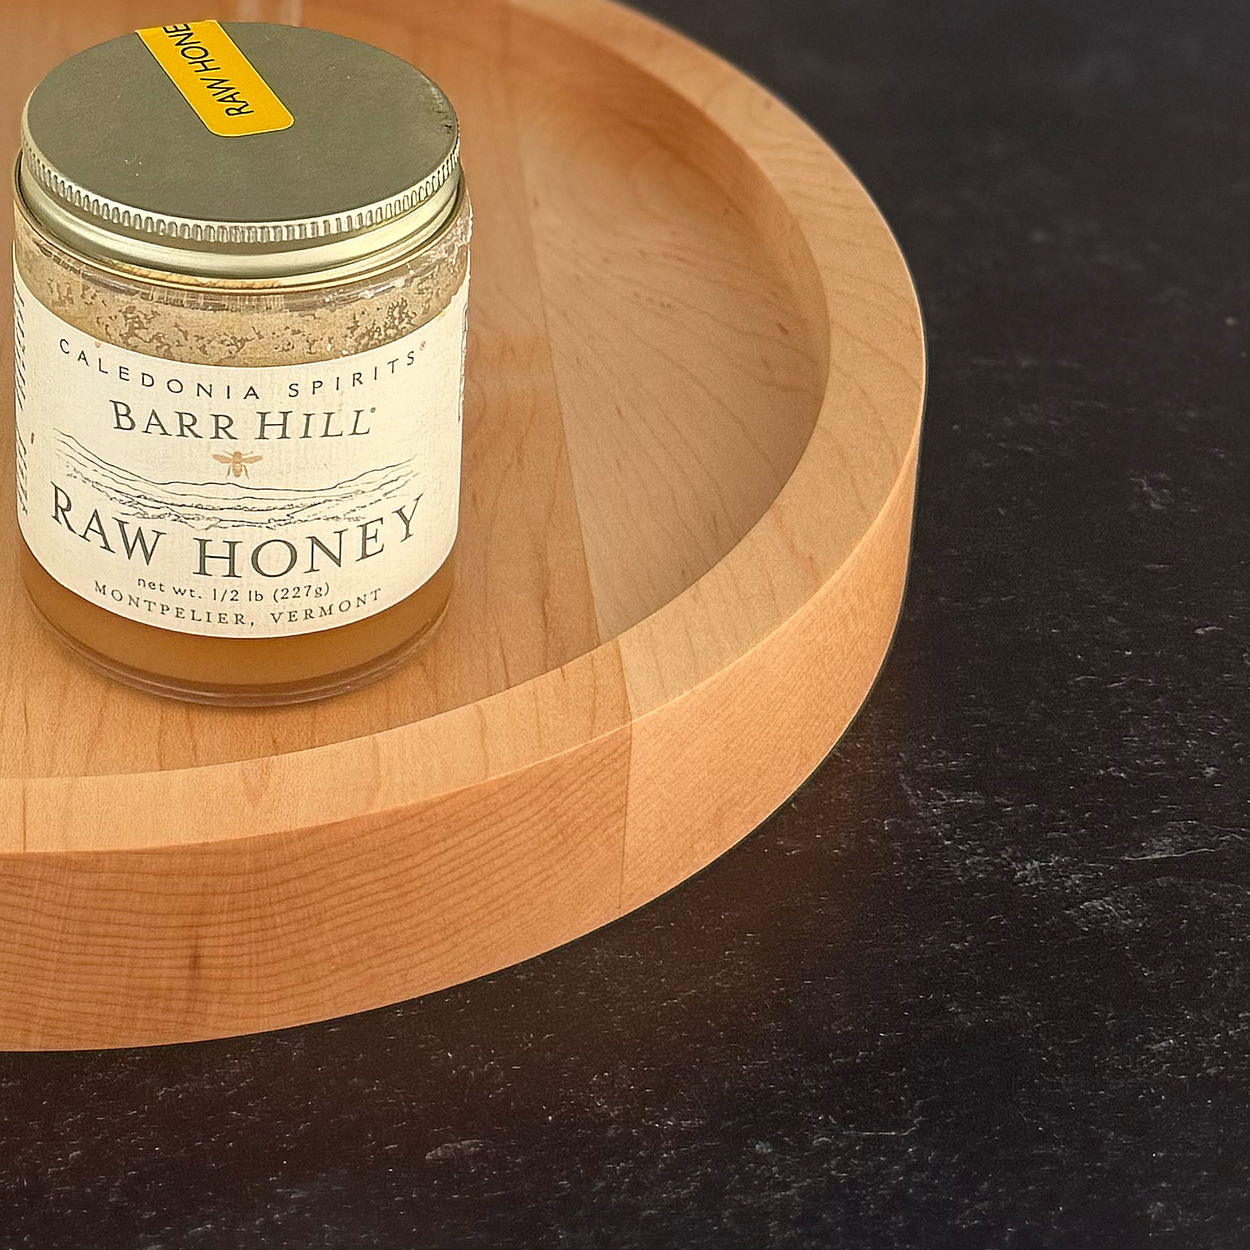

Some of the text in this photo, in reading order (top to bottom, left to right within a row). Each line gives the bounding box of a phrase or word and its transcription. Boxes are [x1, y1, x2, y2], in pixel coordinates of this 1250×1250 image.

[162, 23, 255, 117] RAW HONE
[59, 338, 260, 400] CALEDONIA
[109, 398, 238, 440] BARR
[50, 481, 426, 579] RAW HONEY
[94, 580, 383, 627] MONTPELIER, VERMONT
[137, 576, 331, 603] net wt. 1/2 lb (227g)
